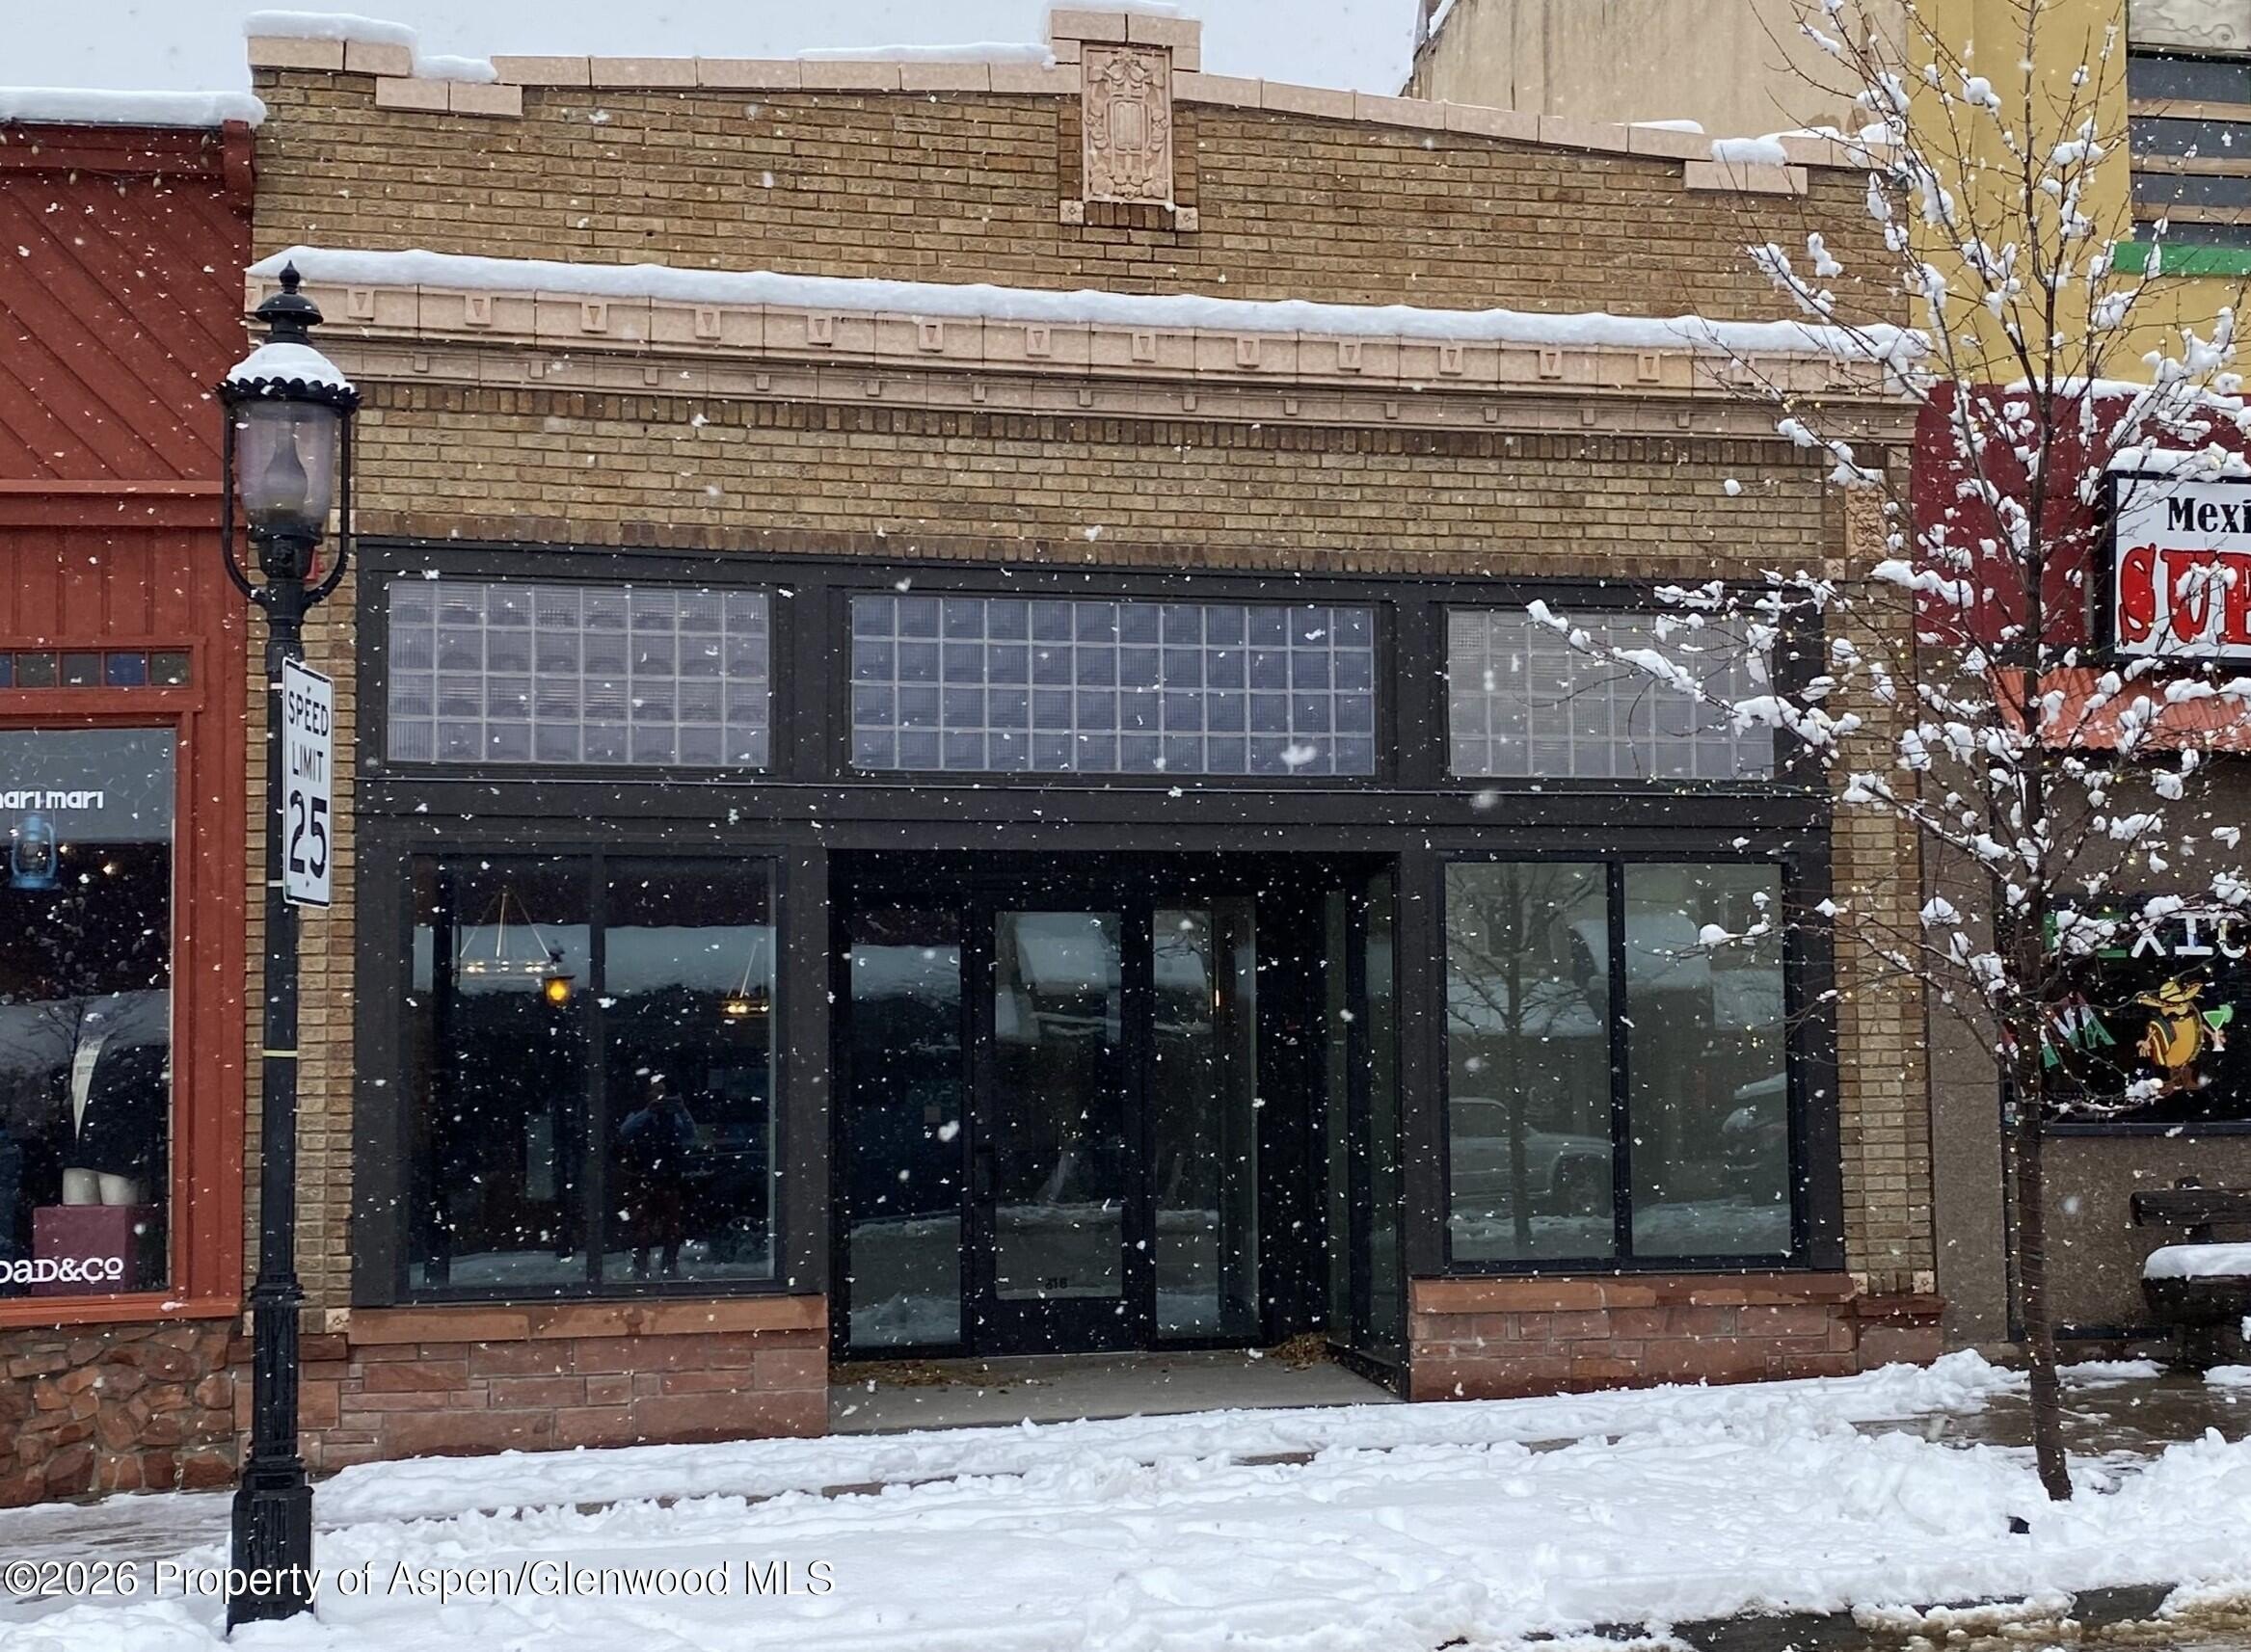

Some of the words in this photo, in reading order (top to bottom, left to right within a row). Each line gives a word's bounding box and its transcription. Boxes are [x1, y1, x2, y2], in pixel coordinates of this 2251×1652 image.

[288, 691, 329, 736] SPEED
[292, 740, 323, 783] LIMIT
[0, 790, 41, 810] ari
[289, 789, 327, 879] 25
